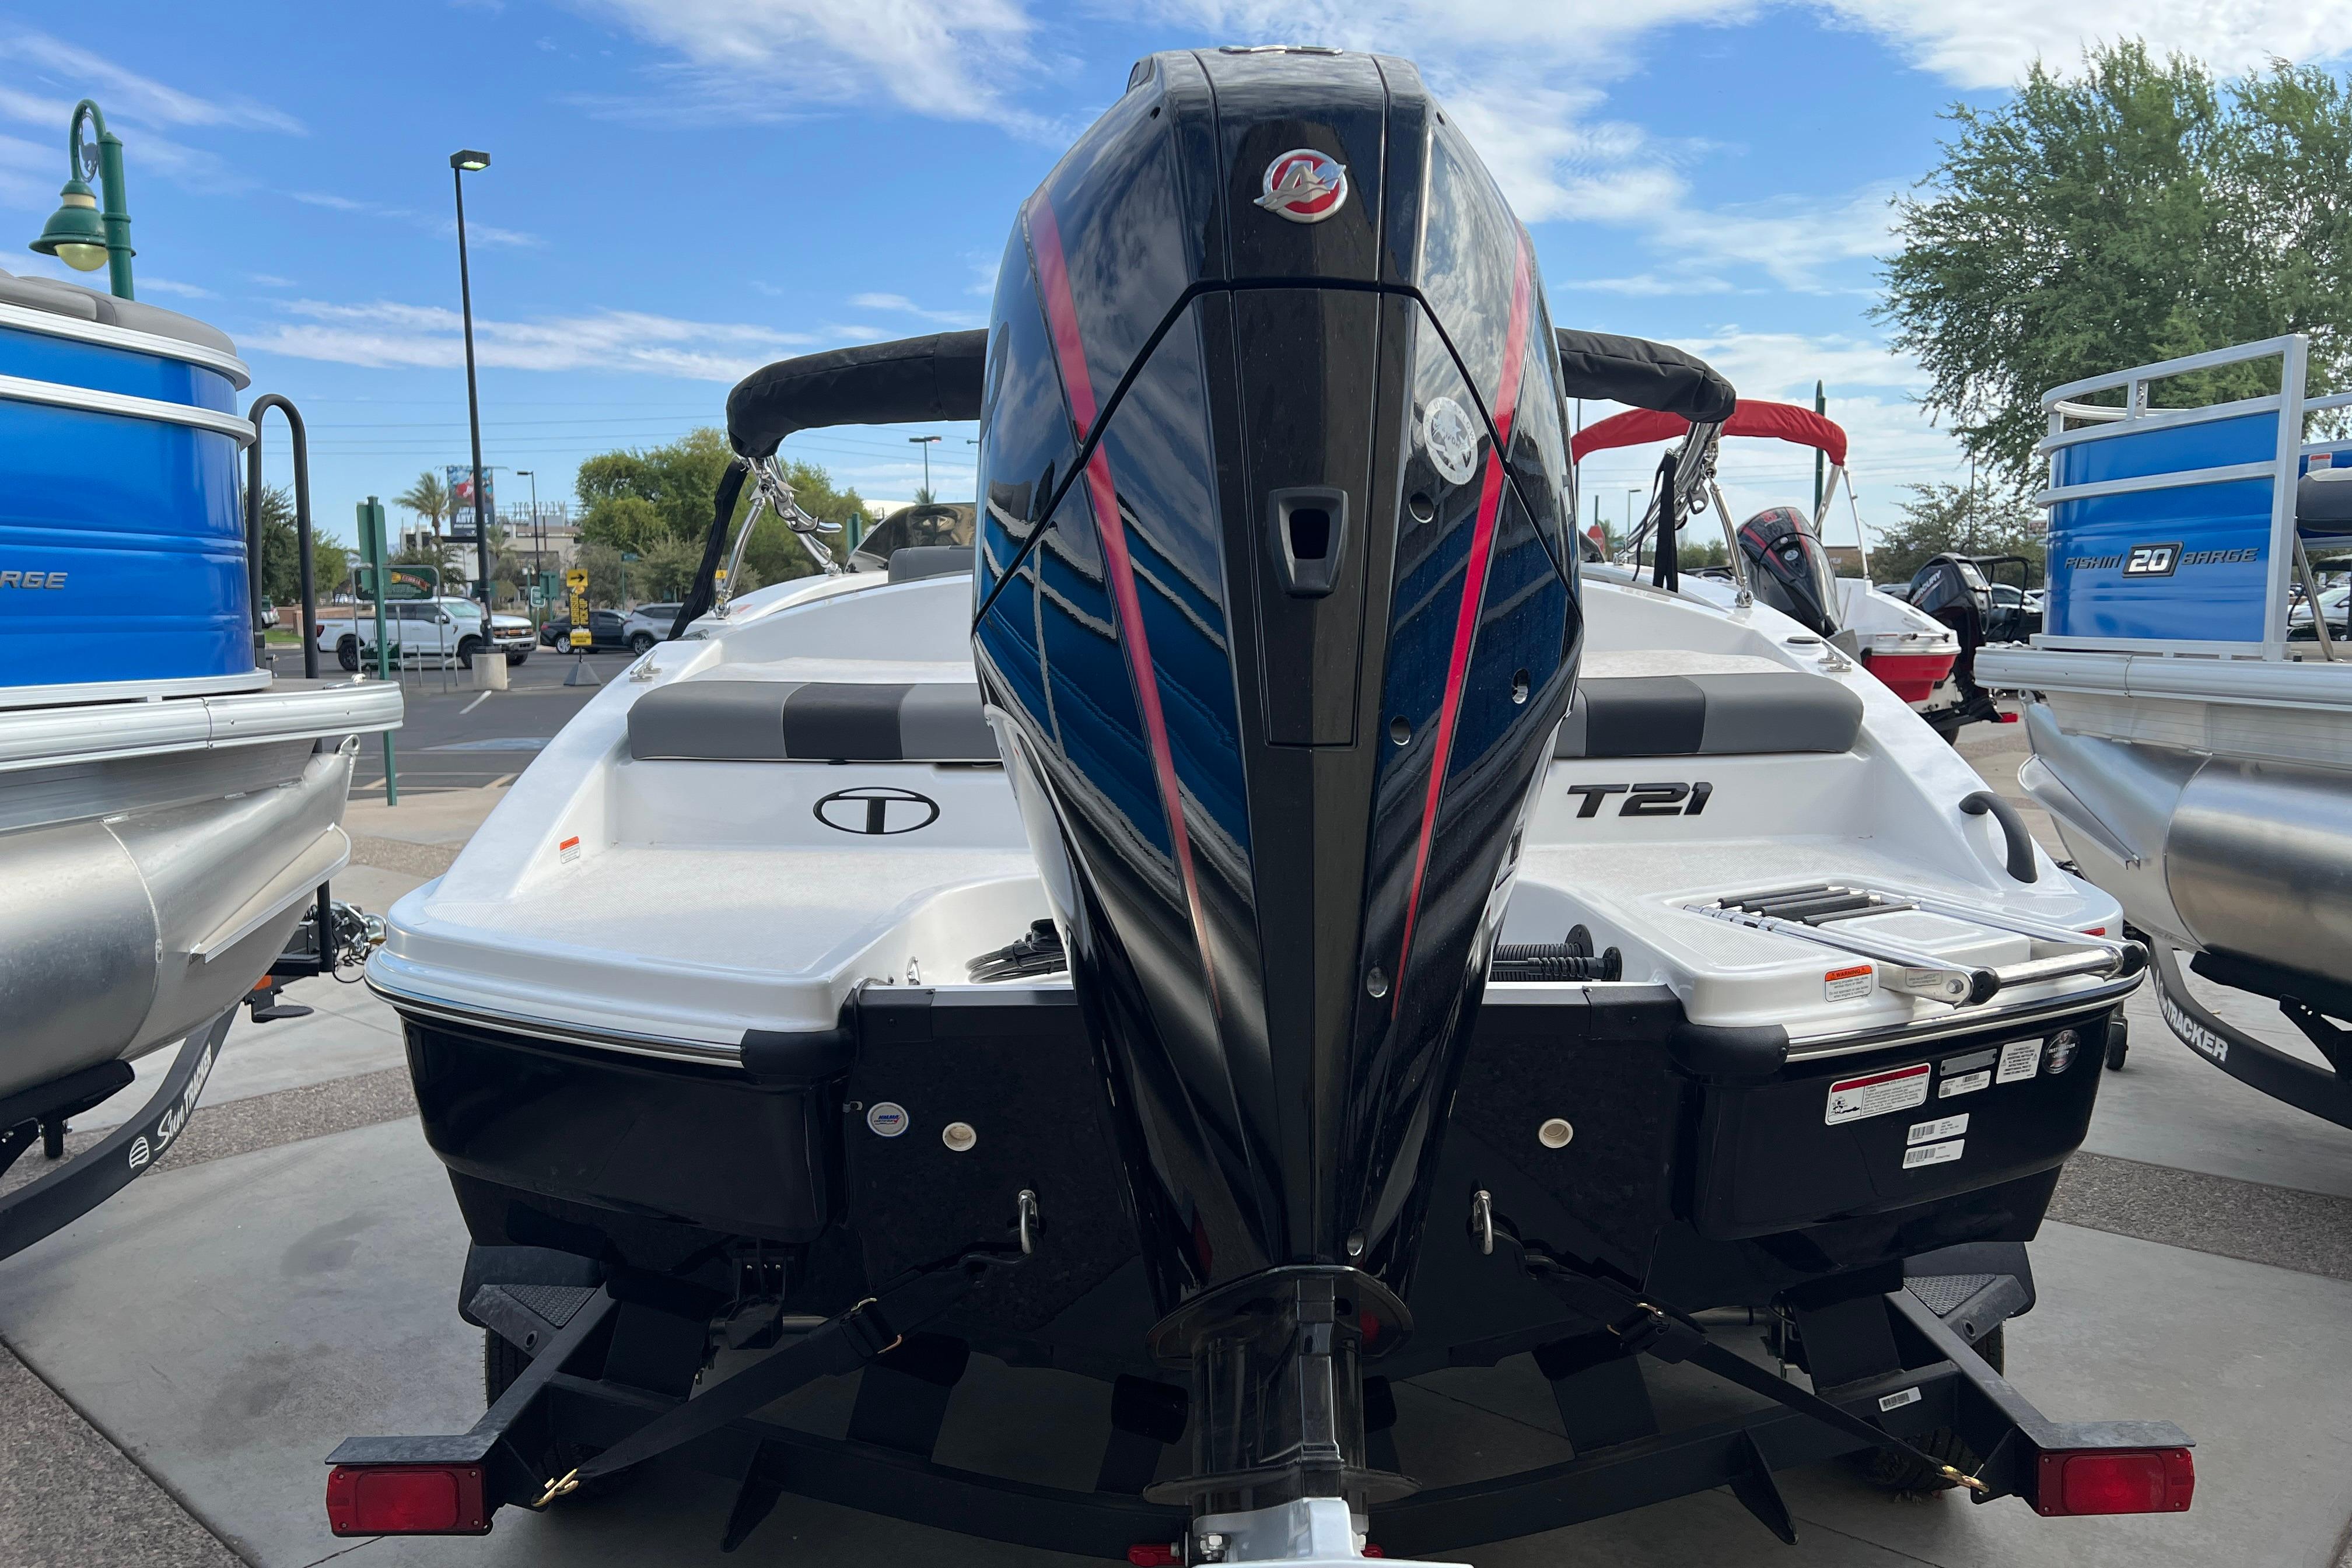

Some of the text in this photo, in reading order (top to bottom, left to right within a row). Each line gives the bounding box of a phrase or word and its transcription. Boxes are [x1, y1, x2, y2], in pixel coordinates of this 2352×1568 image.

[2129, 548, 2172, 572] 20
[2182, 547, 2260, 565] BARGE
[0, 570, 68, 589] RGE
[1567, 782, 1714, 818] T21
[1836, 969, 1861, 978] WARNING
[2166, 996, 2228, 1062] TRACKER
[154, 1041, 212, 1152] Sun TRACKER
